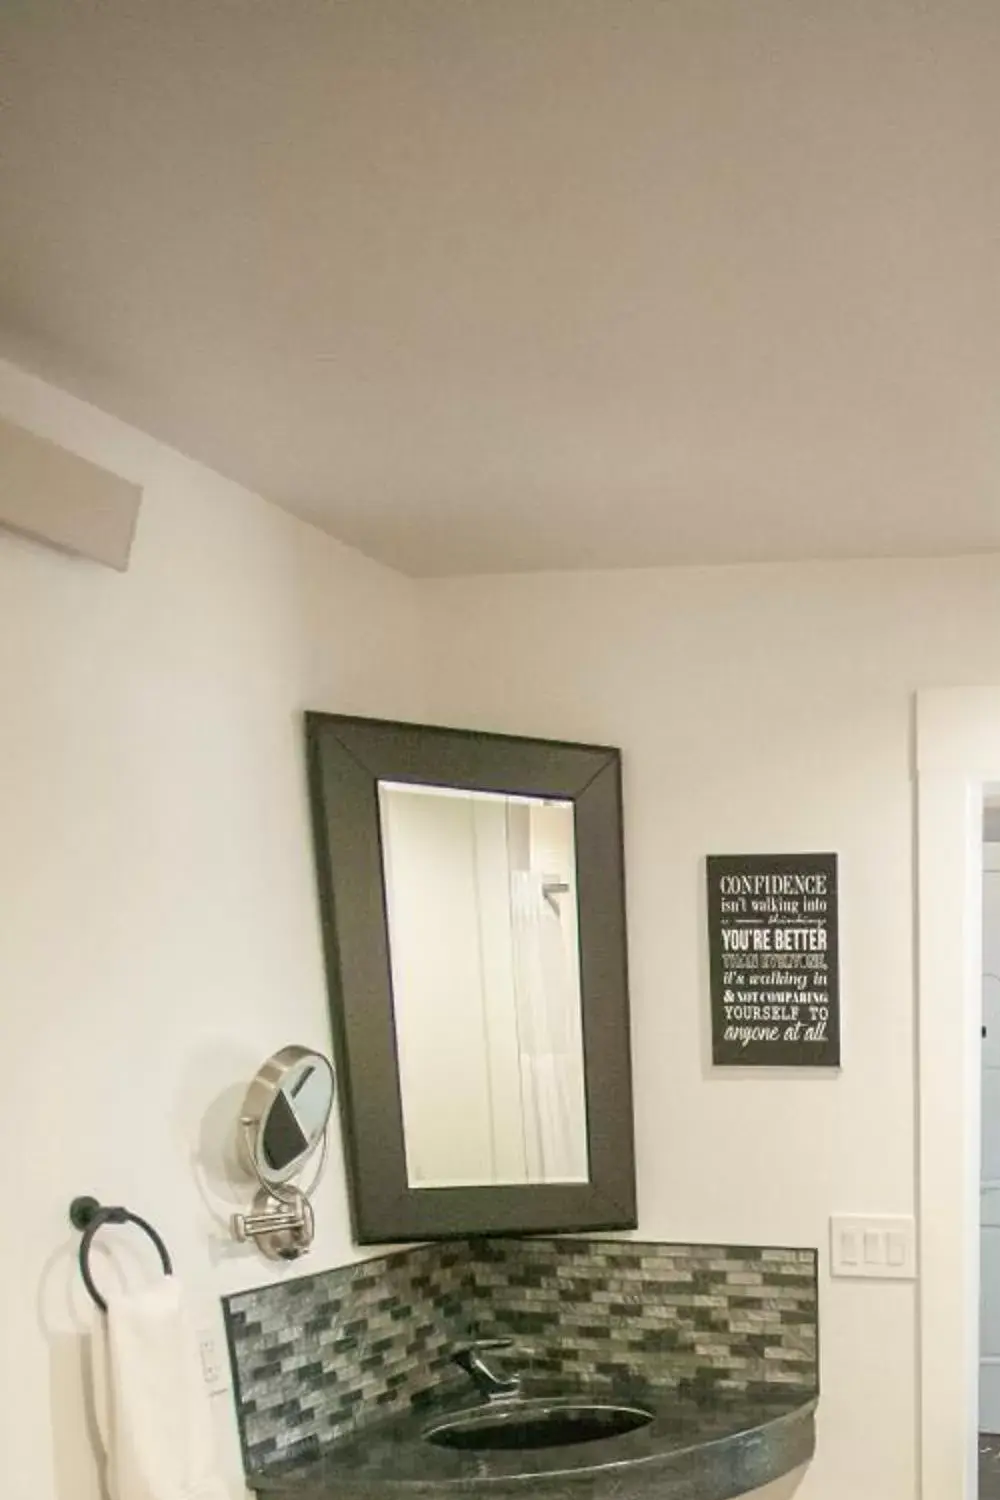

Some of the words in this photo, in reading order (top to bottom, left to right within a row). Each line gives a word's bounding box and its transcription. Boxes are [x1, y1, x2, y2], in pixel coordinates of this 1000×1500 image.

[719, 875, 827, 895] CONFIDENCE
[720, 896, 747, 913] isn't
[751, 896, 799, 914] walking
[803, 896, 827, 912] into
[721, 928, 772, 951] YOU'RE
[774, 928, 827, 951] BETTER
[749, 971, 808, 990] walking
[813, 971, 828, 985] in
[723, 989, 735, 1003] &
[759, 991, 829, 1003] COMPARING
[723, 1005, 799, 1021] YOURSELF
[808, 1005, 829, 1021] TO
[723, 1024, 780, 1047] anyone
[783, 1021, 808, 1041] at
